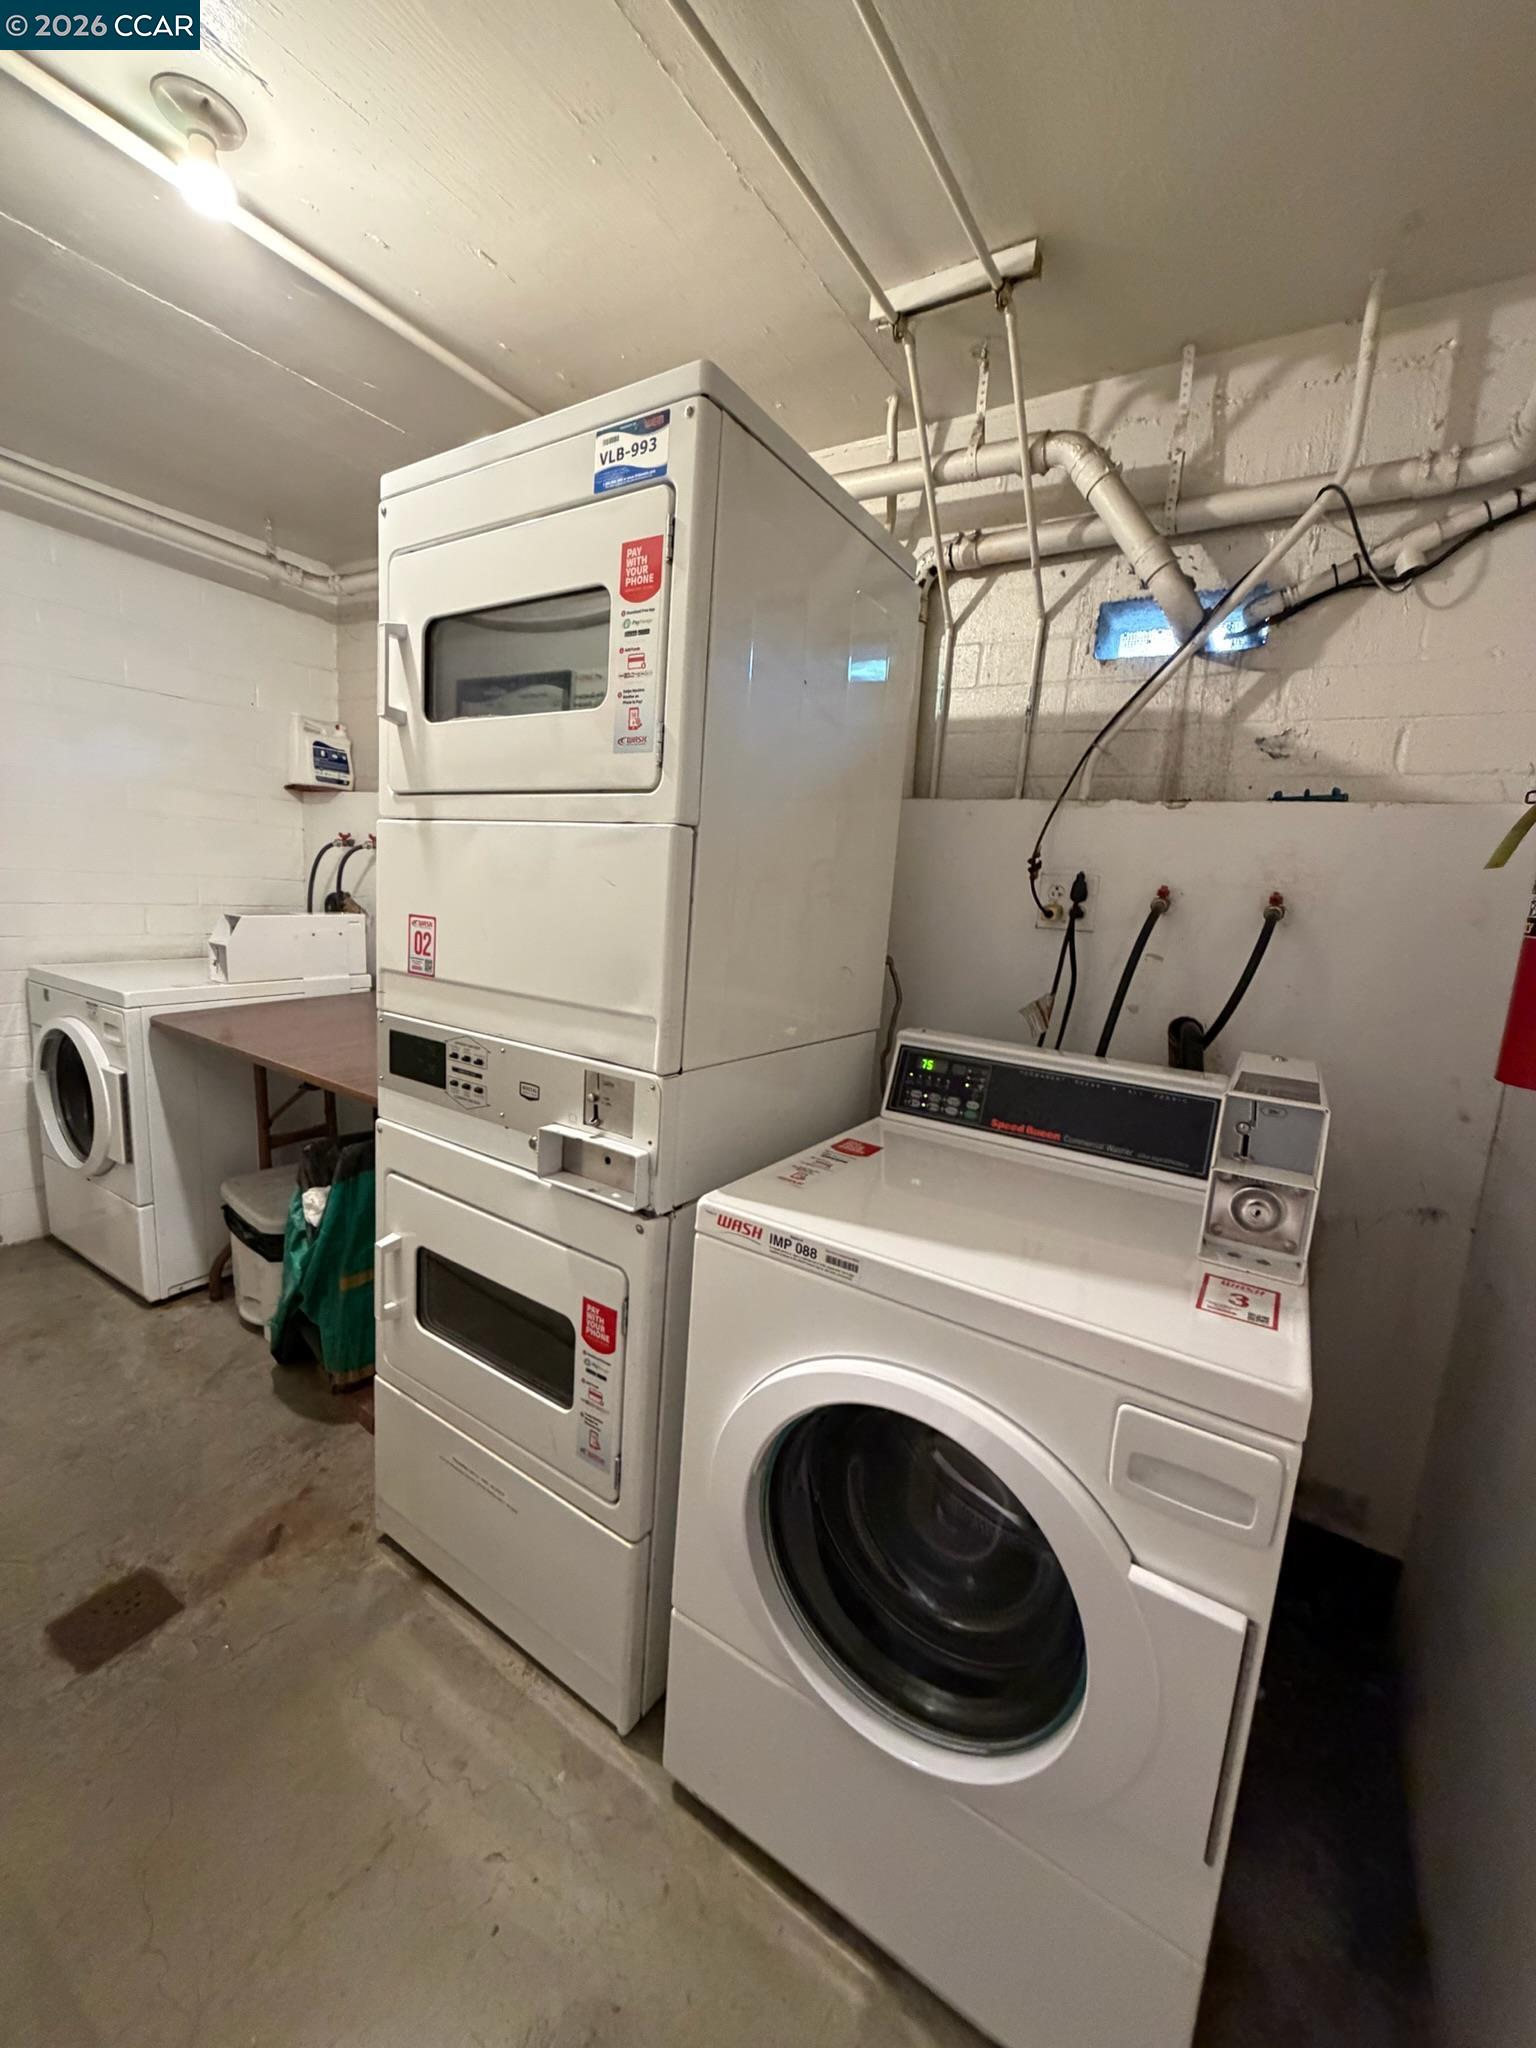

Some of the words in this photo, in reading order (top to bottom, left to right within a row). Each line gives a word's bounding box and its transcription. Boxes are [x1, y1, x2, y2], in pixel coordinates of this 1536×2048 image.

[600, 437, 657, 466] VLB-993
[626, 547, 642, 558] PAY
[626, 555, 648, 568] WITH
[625, 565, 649, 577] YOUR
[625, 573, 654, 587] PHONE
[414, 930, 432, 956] 02
[717, 1214, 764, 1240] WASH
[769, 1233, 793, 1250] IMP
[795, 1243, 818, 1260] 088
[1228, 1292, 1250, 1308] 3
[586, 1303, 600, 1314] PAY
[586, 1311, 605, 1324] WITH
[586, 1319, 606, 1333] YOUR
[586, 1326, 611, 1343] PHONE
